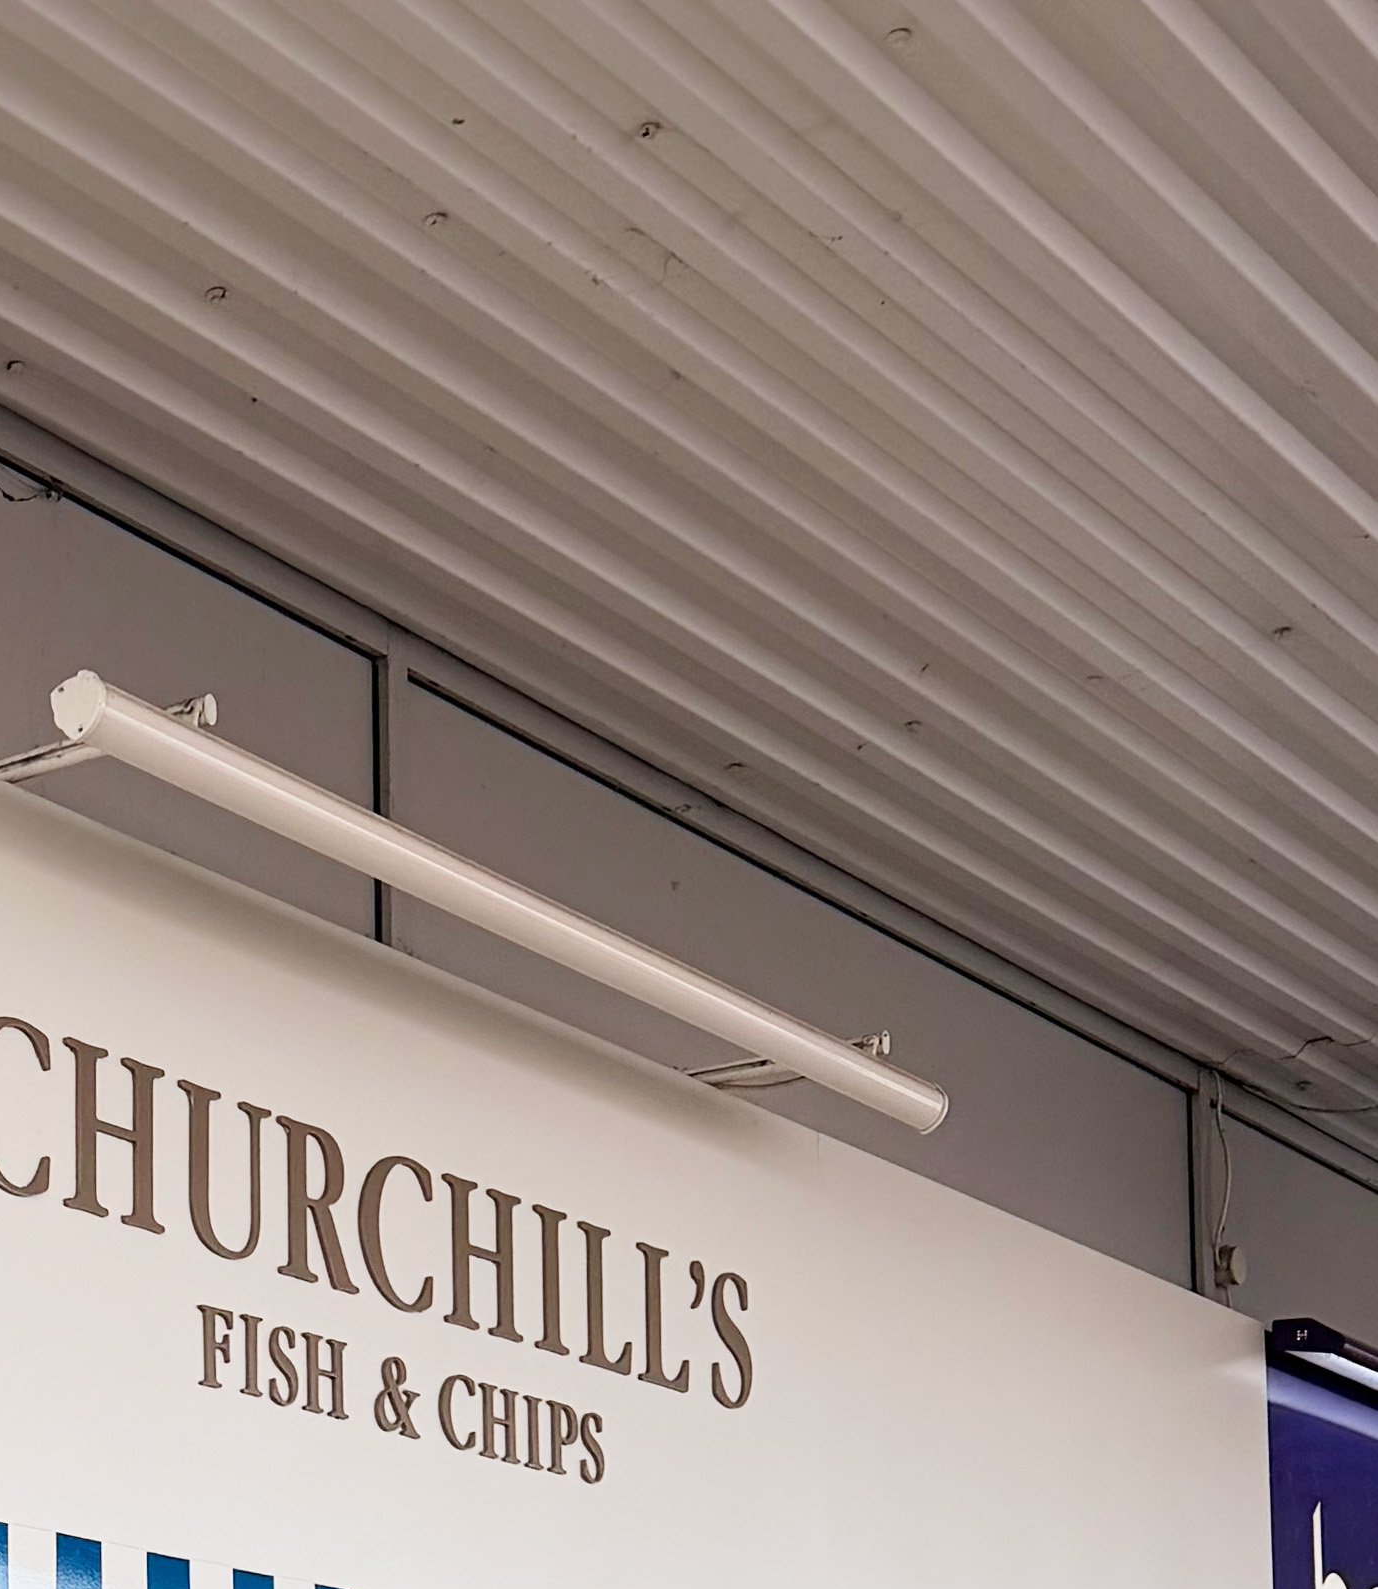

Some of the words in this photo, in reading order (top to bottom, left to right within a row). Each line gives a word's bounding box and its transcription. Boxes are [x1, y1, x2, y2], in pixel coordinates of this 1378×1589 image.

[196, 1303, 350, 1421] FISH
[373, 1355, 422, 1440] &
[440, 1373, 607, 1485] CHIPS
